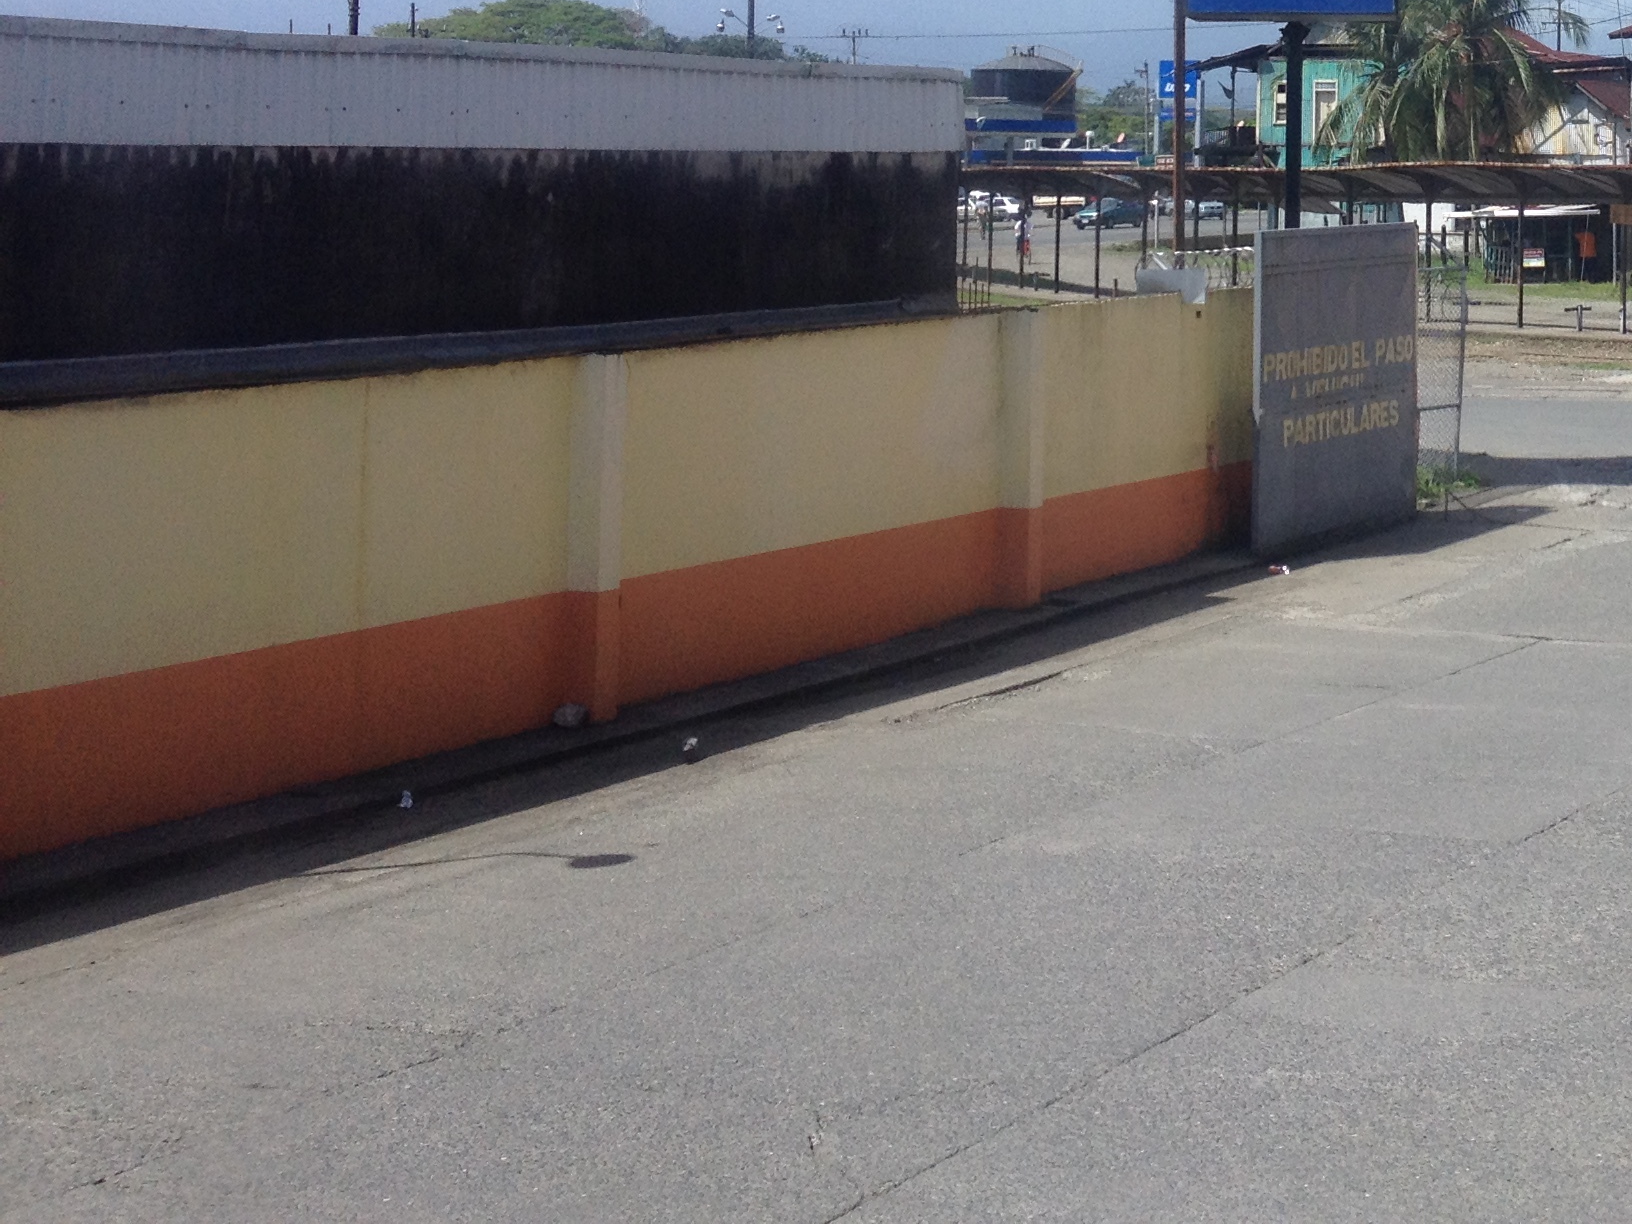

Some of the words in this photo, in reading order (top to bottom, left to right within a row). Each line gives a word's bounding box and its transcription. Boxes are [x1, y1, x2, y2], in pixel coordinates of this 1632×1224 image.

[1263, 344, 1348, 383] PROHIBIDO
[1351, 340, 1371, 369] EL
[1375, 334, 1414, 366] PASO
[1283, 399, 1400, 449] PARTICULARES
